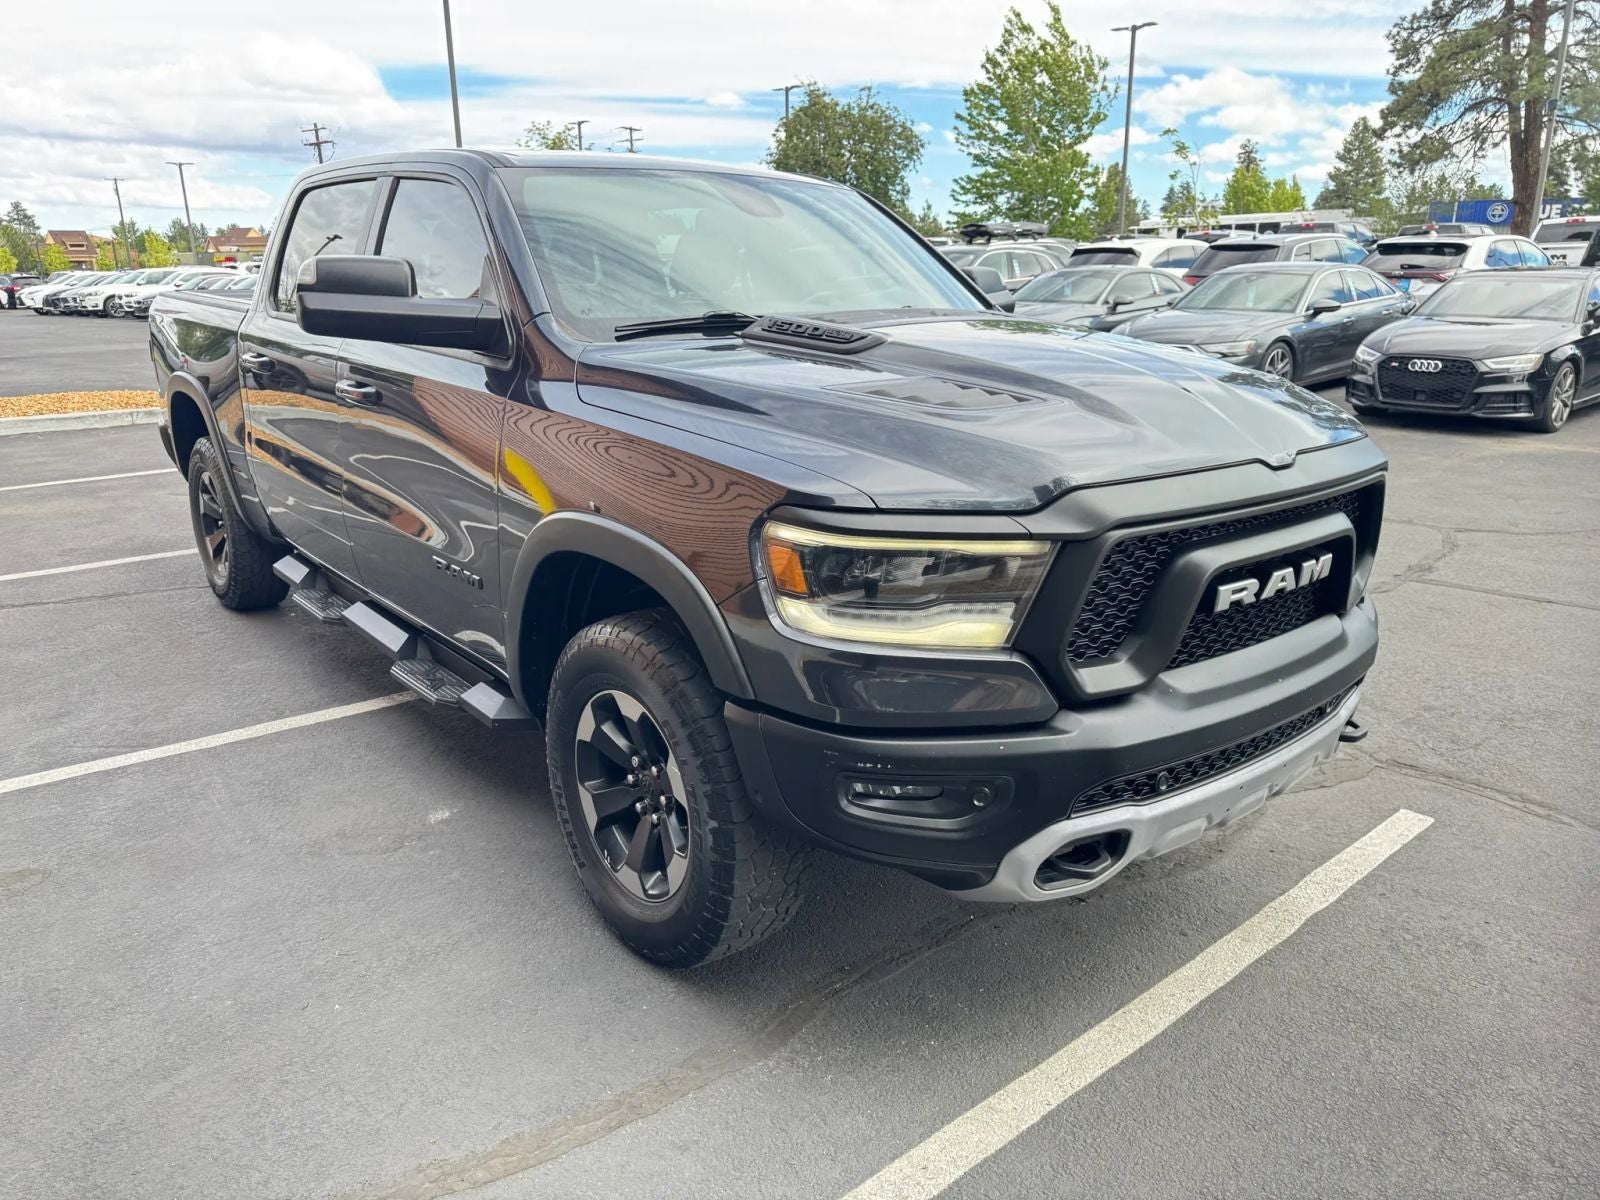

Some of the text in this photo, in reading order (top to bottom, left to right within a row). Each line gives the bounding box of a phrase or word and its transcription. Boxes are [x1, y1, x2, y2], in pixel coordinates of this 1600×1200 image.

[766, 317, 827, 337] 1500
[432, 555, 484, 590] RAM
[1214, 552, 1333, 613] RAM
